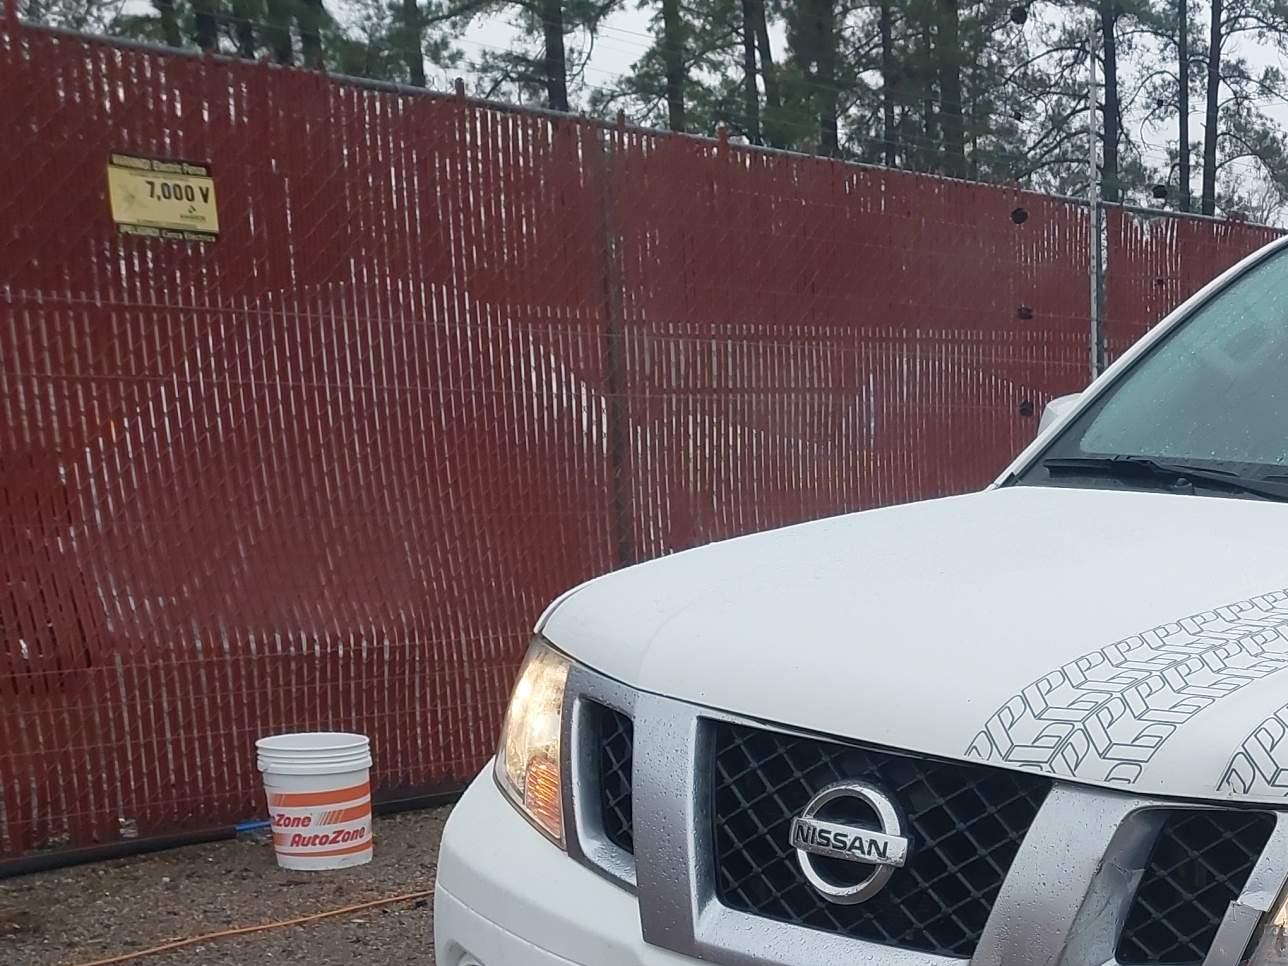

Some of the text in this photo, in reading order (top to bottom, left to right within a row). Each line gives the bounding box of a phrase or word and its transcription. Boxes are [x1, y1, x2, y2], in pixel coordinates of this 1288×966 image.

[145, 180, 210, 204] 7,000 V
[290, 826, 366, 848] AutoZone
[796, 825, 889, 859] NISSAN
